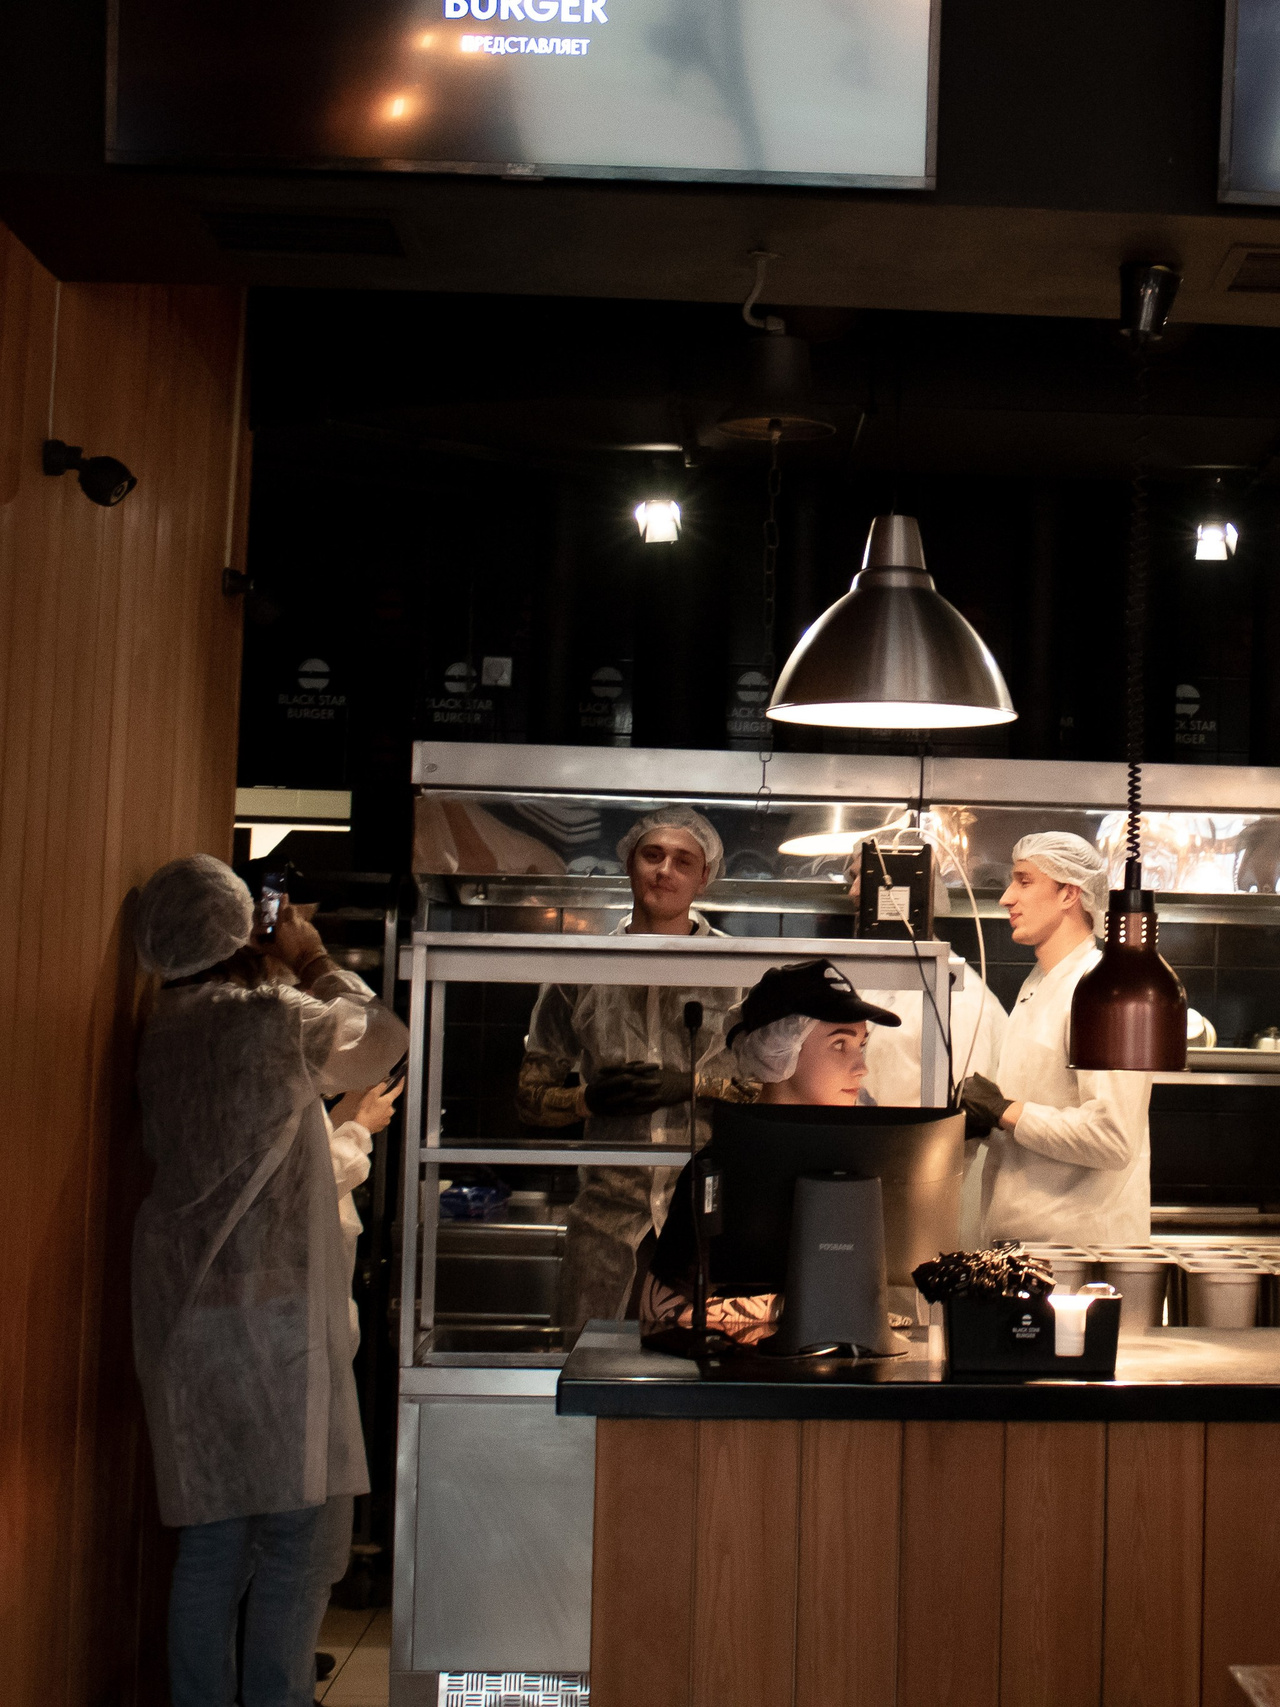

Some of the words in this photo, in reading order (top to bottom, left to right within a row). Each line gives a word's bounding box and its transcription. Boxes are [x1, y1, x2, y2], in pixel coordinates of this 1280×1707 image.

[444, 0, 609, 24] BURGER
[461, 34, 591, 55] ПРЕДСТАВЛЯЕТ
[278, 693, 315, 705] BLACK
[318, 694, 348, 706] STAR
[286, 707, 336, 720] BURGER
[1189, 719, 1217, 732] STAR
[1174, 732, 1206, 745] RGER
